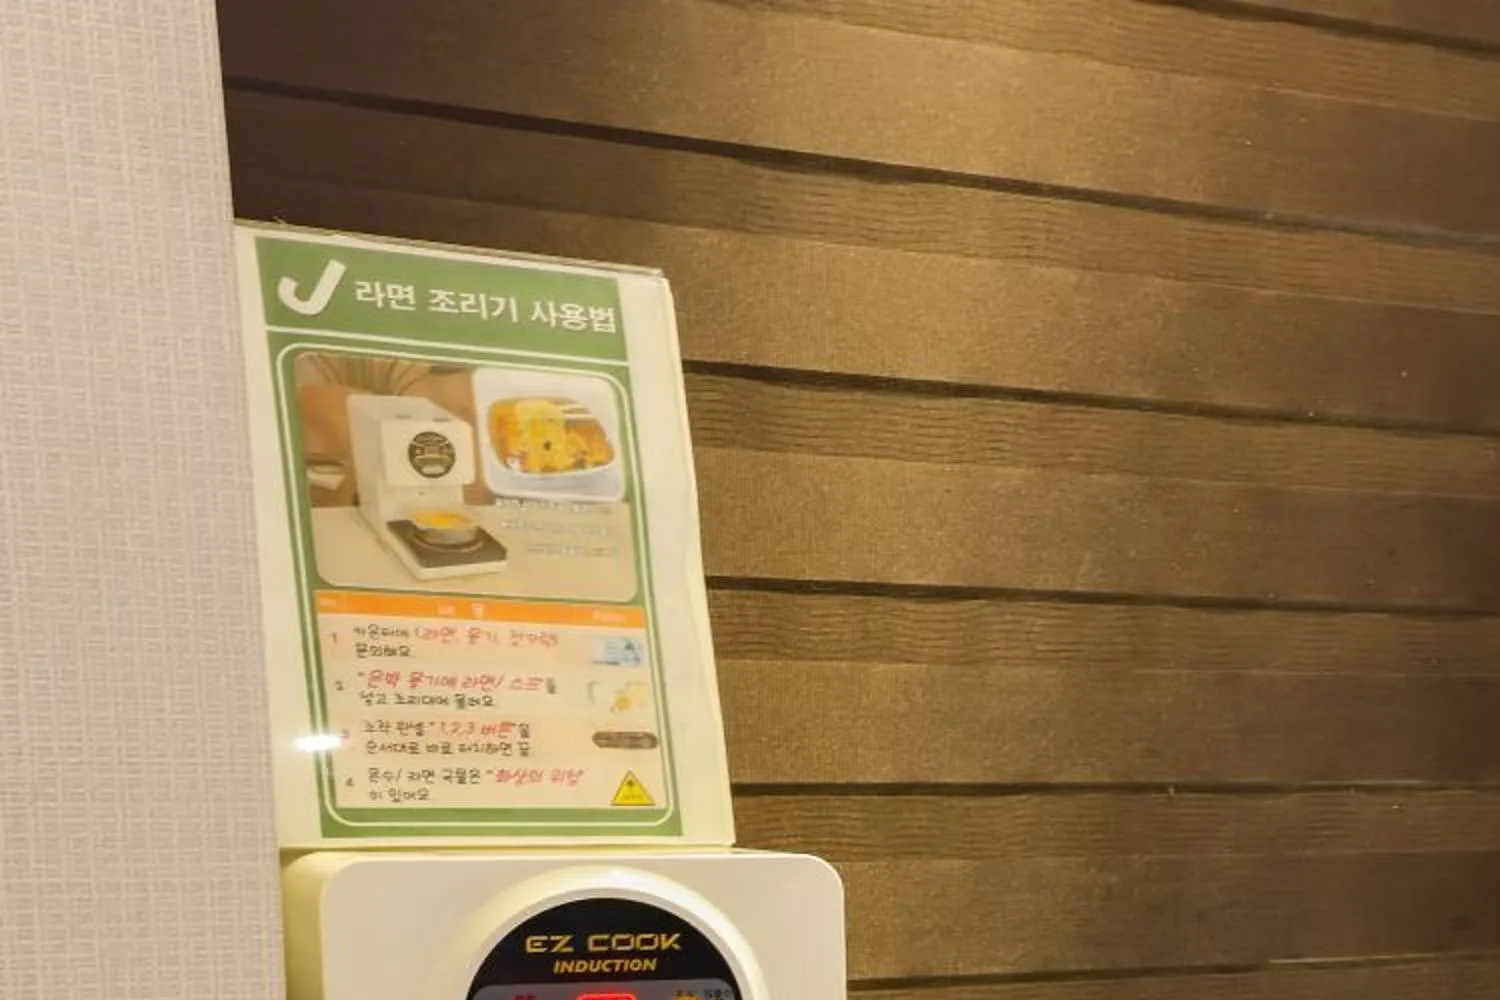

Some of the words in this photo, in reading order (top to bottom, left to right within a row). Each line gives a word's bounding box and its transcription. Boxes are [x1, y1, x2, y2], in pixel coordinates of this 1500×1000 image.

[354, 280, 417, 311] 라면
[427, 287, 519, 323] 조리기
[530, 300, 617, 334] 사용법
[525, 933, 576, 954] EZ
[586, 932, 683, 952] COOK
[553, 957, 658, 975] INDUCTION
